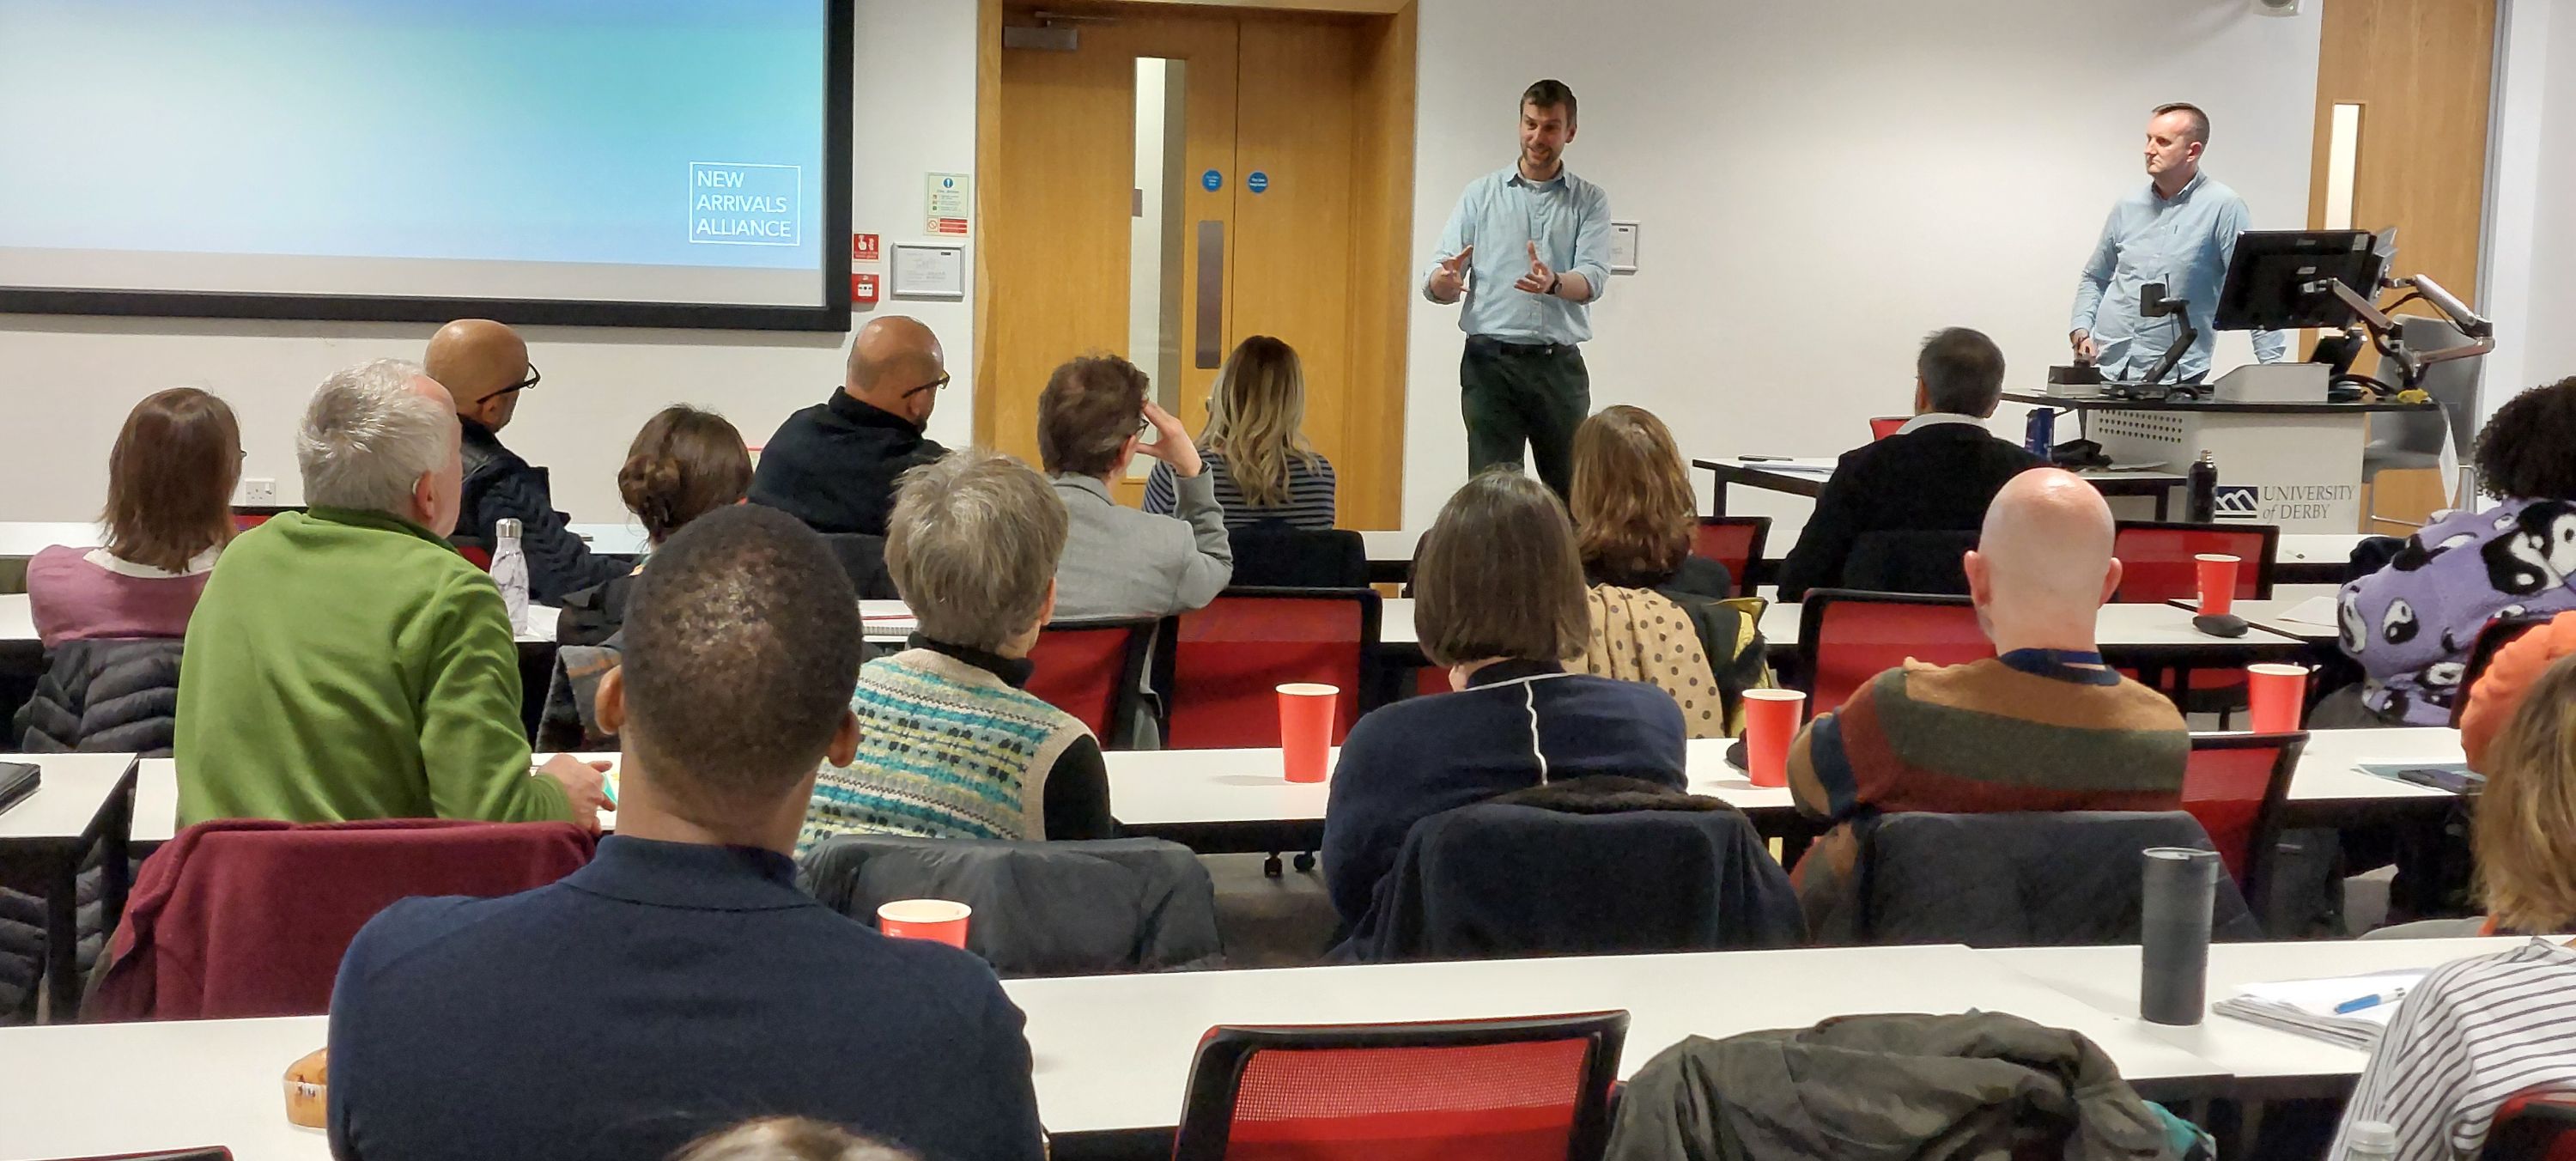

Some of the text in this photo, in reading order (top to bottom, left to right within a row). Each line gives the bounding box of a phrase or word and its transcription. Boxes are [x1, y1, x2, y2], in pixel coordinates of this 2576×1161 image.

[697, 170, 744, 188] NEW
[696, 194, 787, 213] ARRIVALS
[696, 218, 792, 238] ALLIANCE
[2263, 485, 2356, 501] UNIVERSITY
[2263, 504, 2330, 524] of DERBY
